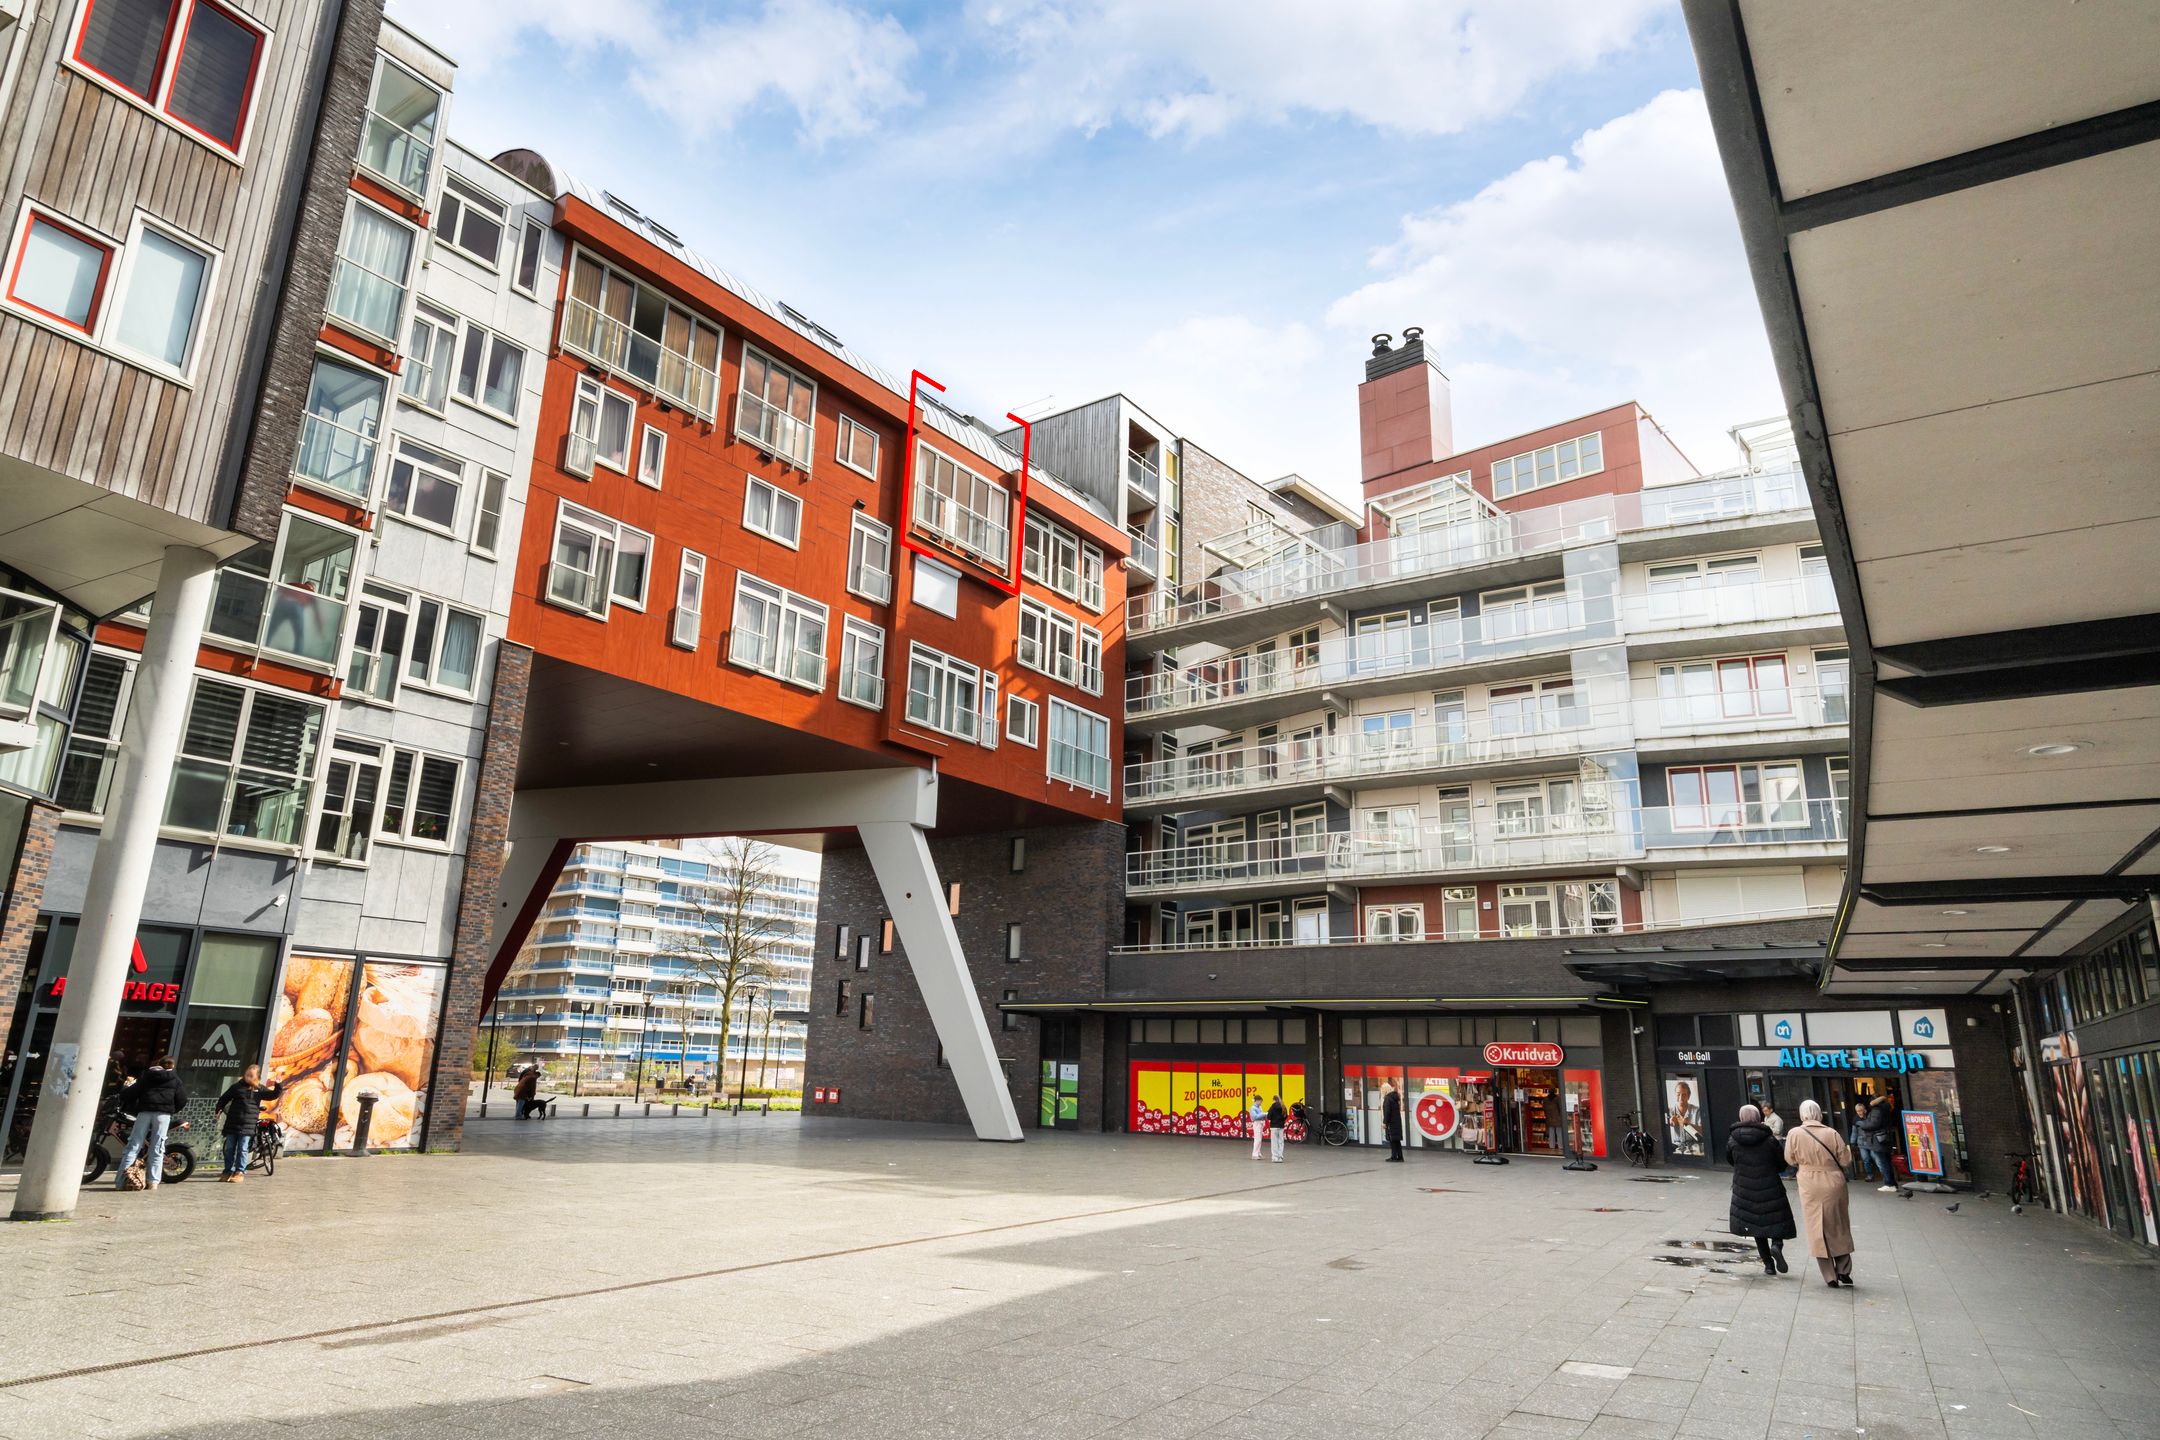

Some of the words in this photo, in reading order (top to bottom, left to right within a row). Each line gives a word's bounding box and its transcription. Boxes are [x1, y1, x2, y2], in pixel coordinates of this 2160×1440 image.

[51, 977, 179, 1002] ATAGE
[1503, 1048, 1558, 1061] Kruidvat
[1778, 1048, 1850, 1069] Albert
[1857, 1048, 1924, 1074] Heijn
[192, 1058, 241, 1068] AVANTAGE
[1184, 1090, 1196, 1101] ZO
